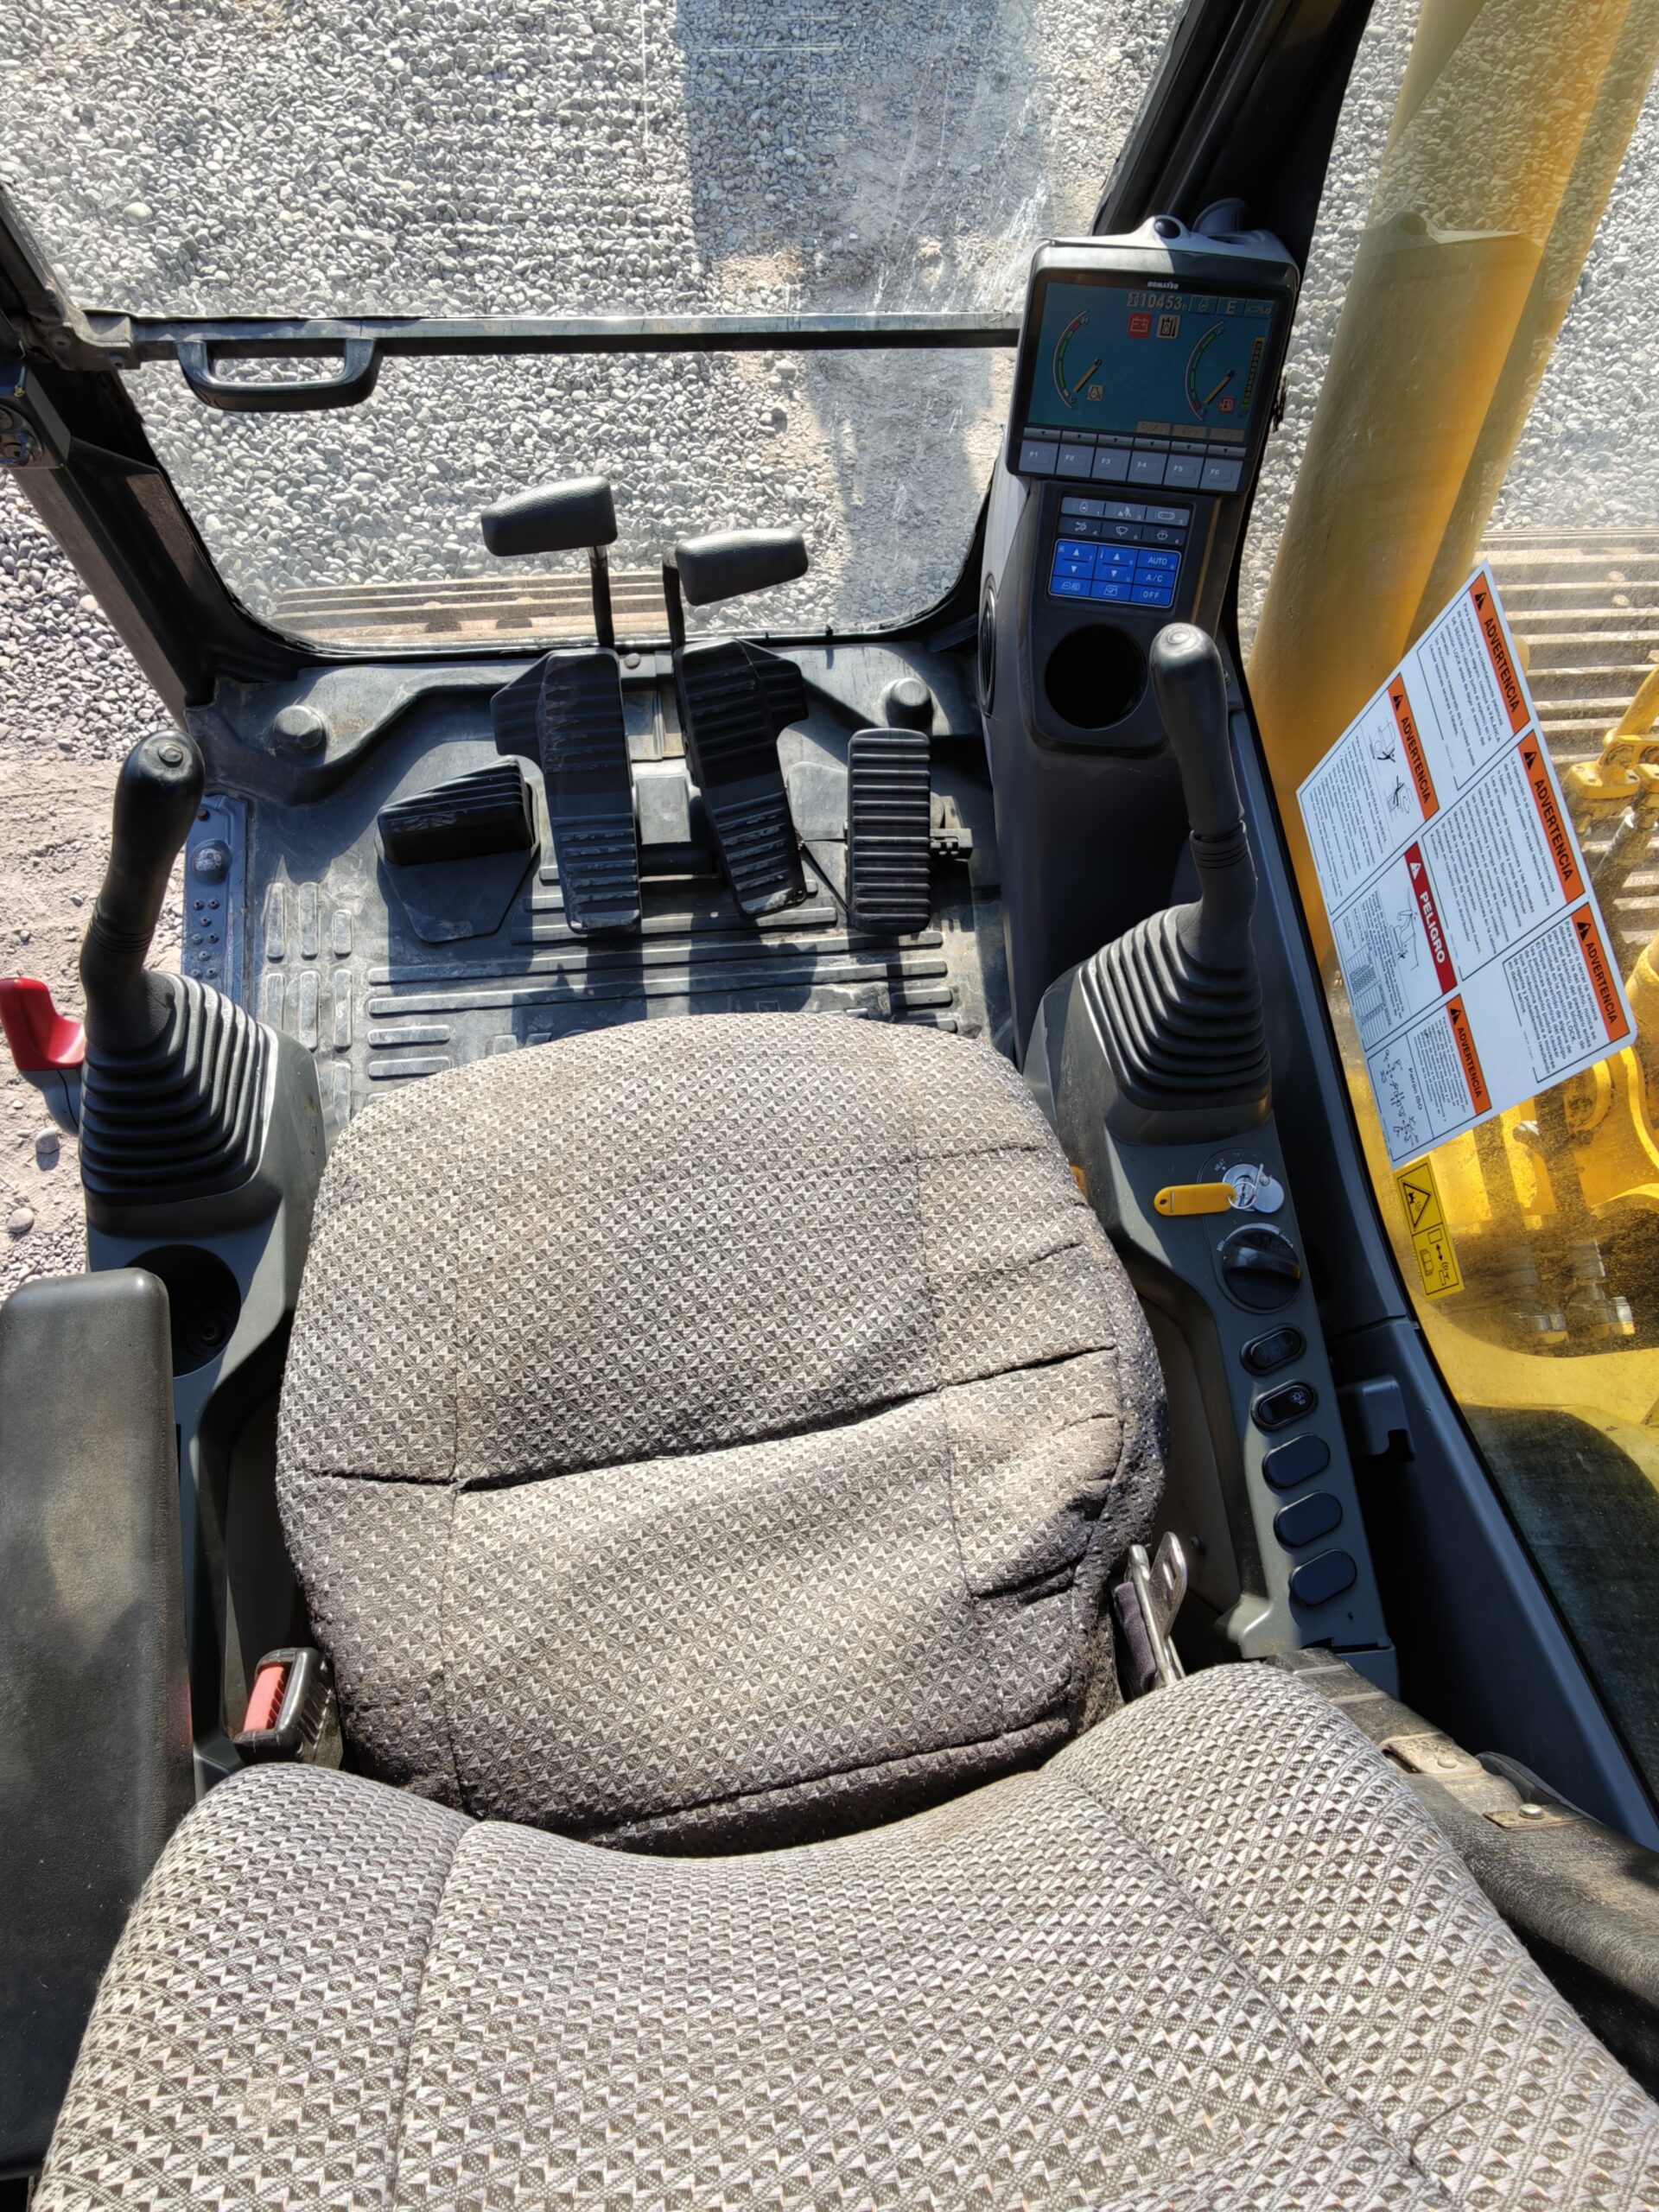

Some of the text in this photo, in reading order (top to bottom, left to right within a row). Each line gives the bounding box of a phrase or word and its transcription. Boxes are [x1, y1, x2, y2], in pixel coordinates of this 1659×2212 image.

[1147, 281, 1179, 289] KOMATSU
[1226, 301, 1236, 314] E
[1142, 590, 1160, 600] OFF
[1146, 573, 1163, 582] A/C
[1147, 556, 1168, 566] AUTO
[1484, 617, 1519, 713] ADVERTENCIA
[1401, 715, 1431, 804] ADVERTENCIA
[1534, 779, 1573, 881] ADVERTENCIA
[1420, 891, 1445, 963] PELIGRO
[1585, 942, 1618, 1024] ADVERTENCIA
[1457, 1027, 1482, 1097] ADVERTENCIA
